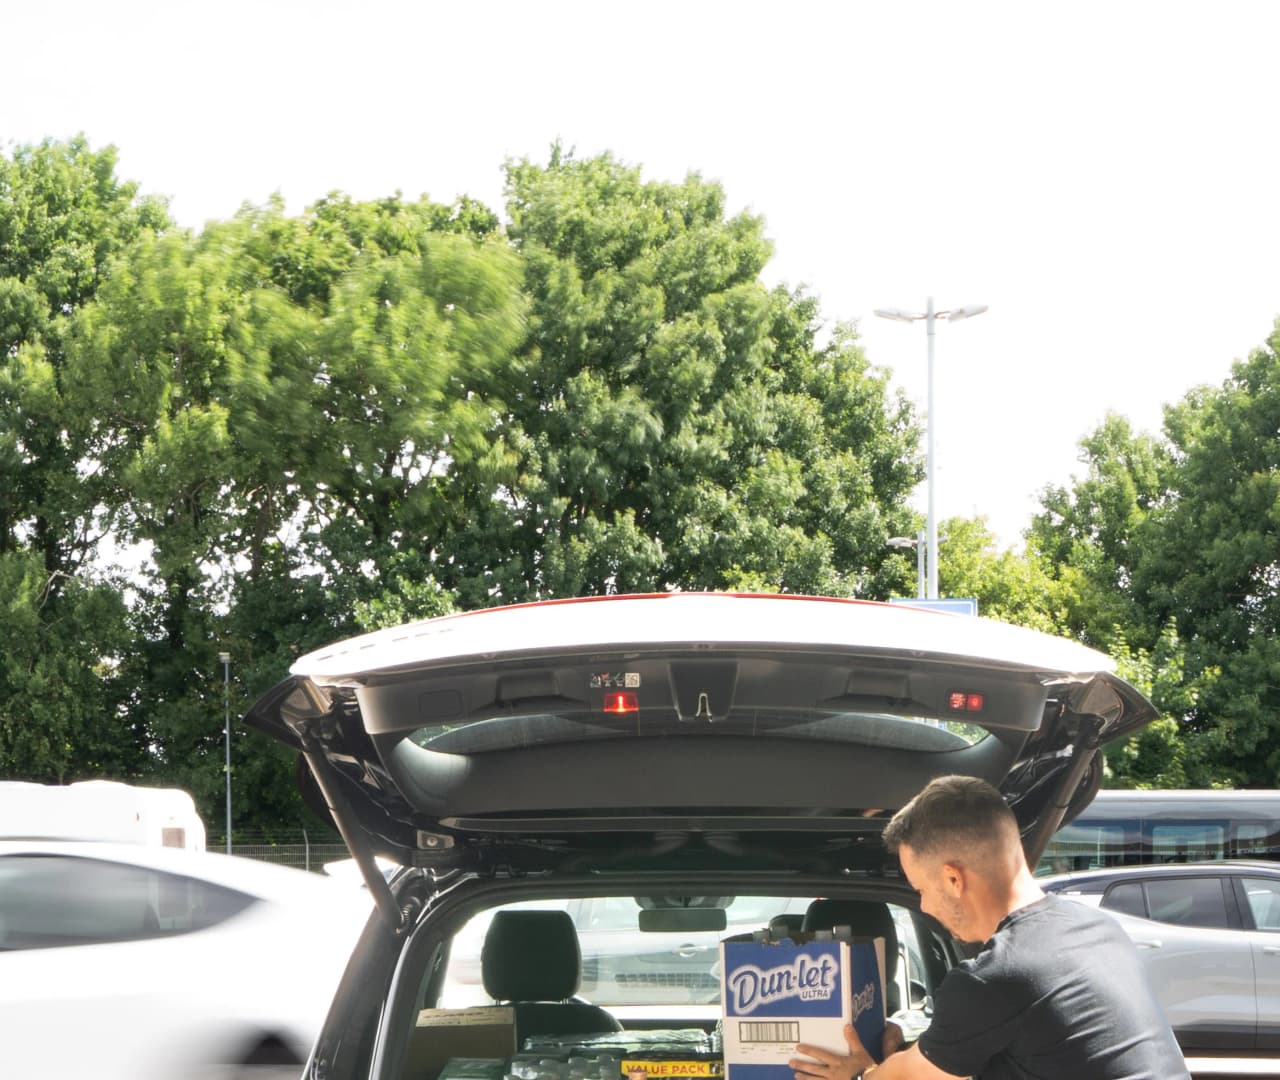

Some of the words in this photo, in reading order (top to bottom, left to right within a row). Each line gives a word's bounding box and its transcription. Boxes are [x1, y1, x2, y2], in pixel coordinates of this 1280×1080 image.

[802, 989, 829, 999] ULTRA
[626, 1064, 668, 1074] VALUE
[671, 1064, 705, 1074] PACK
